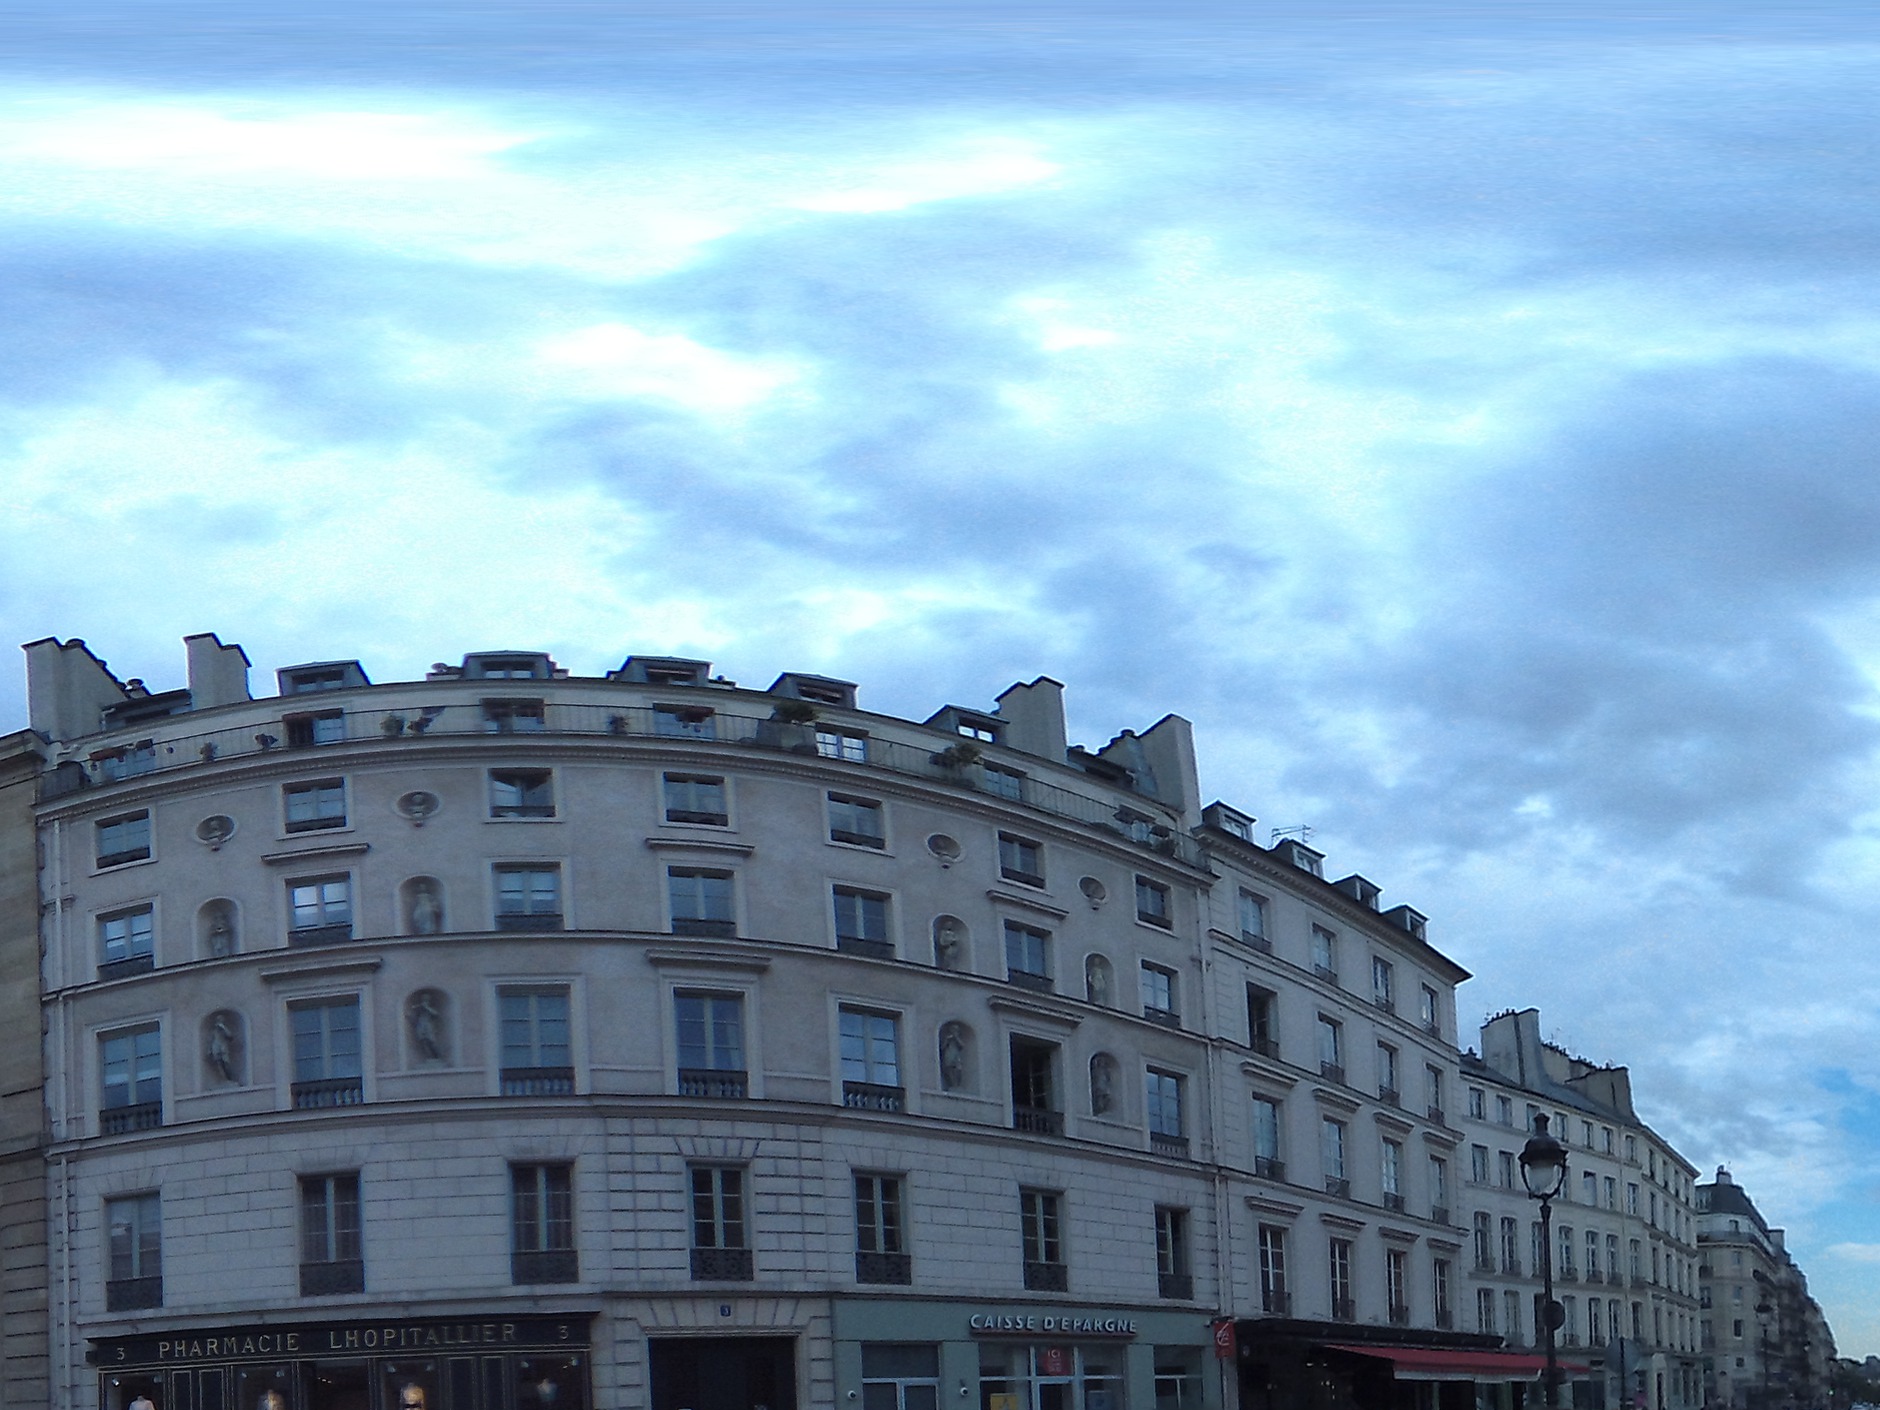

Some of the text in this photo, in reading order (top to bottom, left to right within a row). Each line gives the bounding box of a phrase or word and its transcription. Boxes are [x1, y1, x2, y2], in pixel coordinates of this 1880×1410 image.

[969, 1313, 1138, 1334] CAISSE D'EPARGNE
[116, 1324, 569, 1361] 3 PHARMACIE LHOPITALLIER 3
